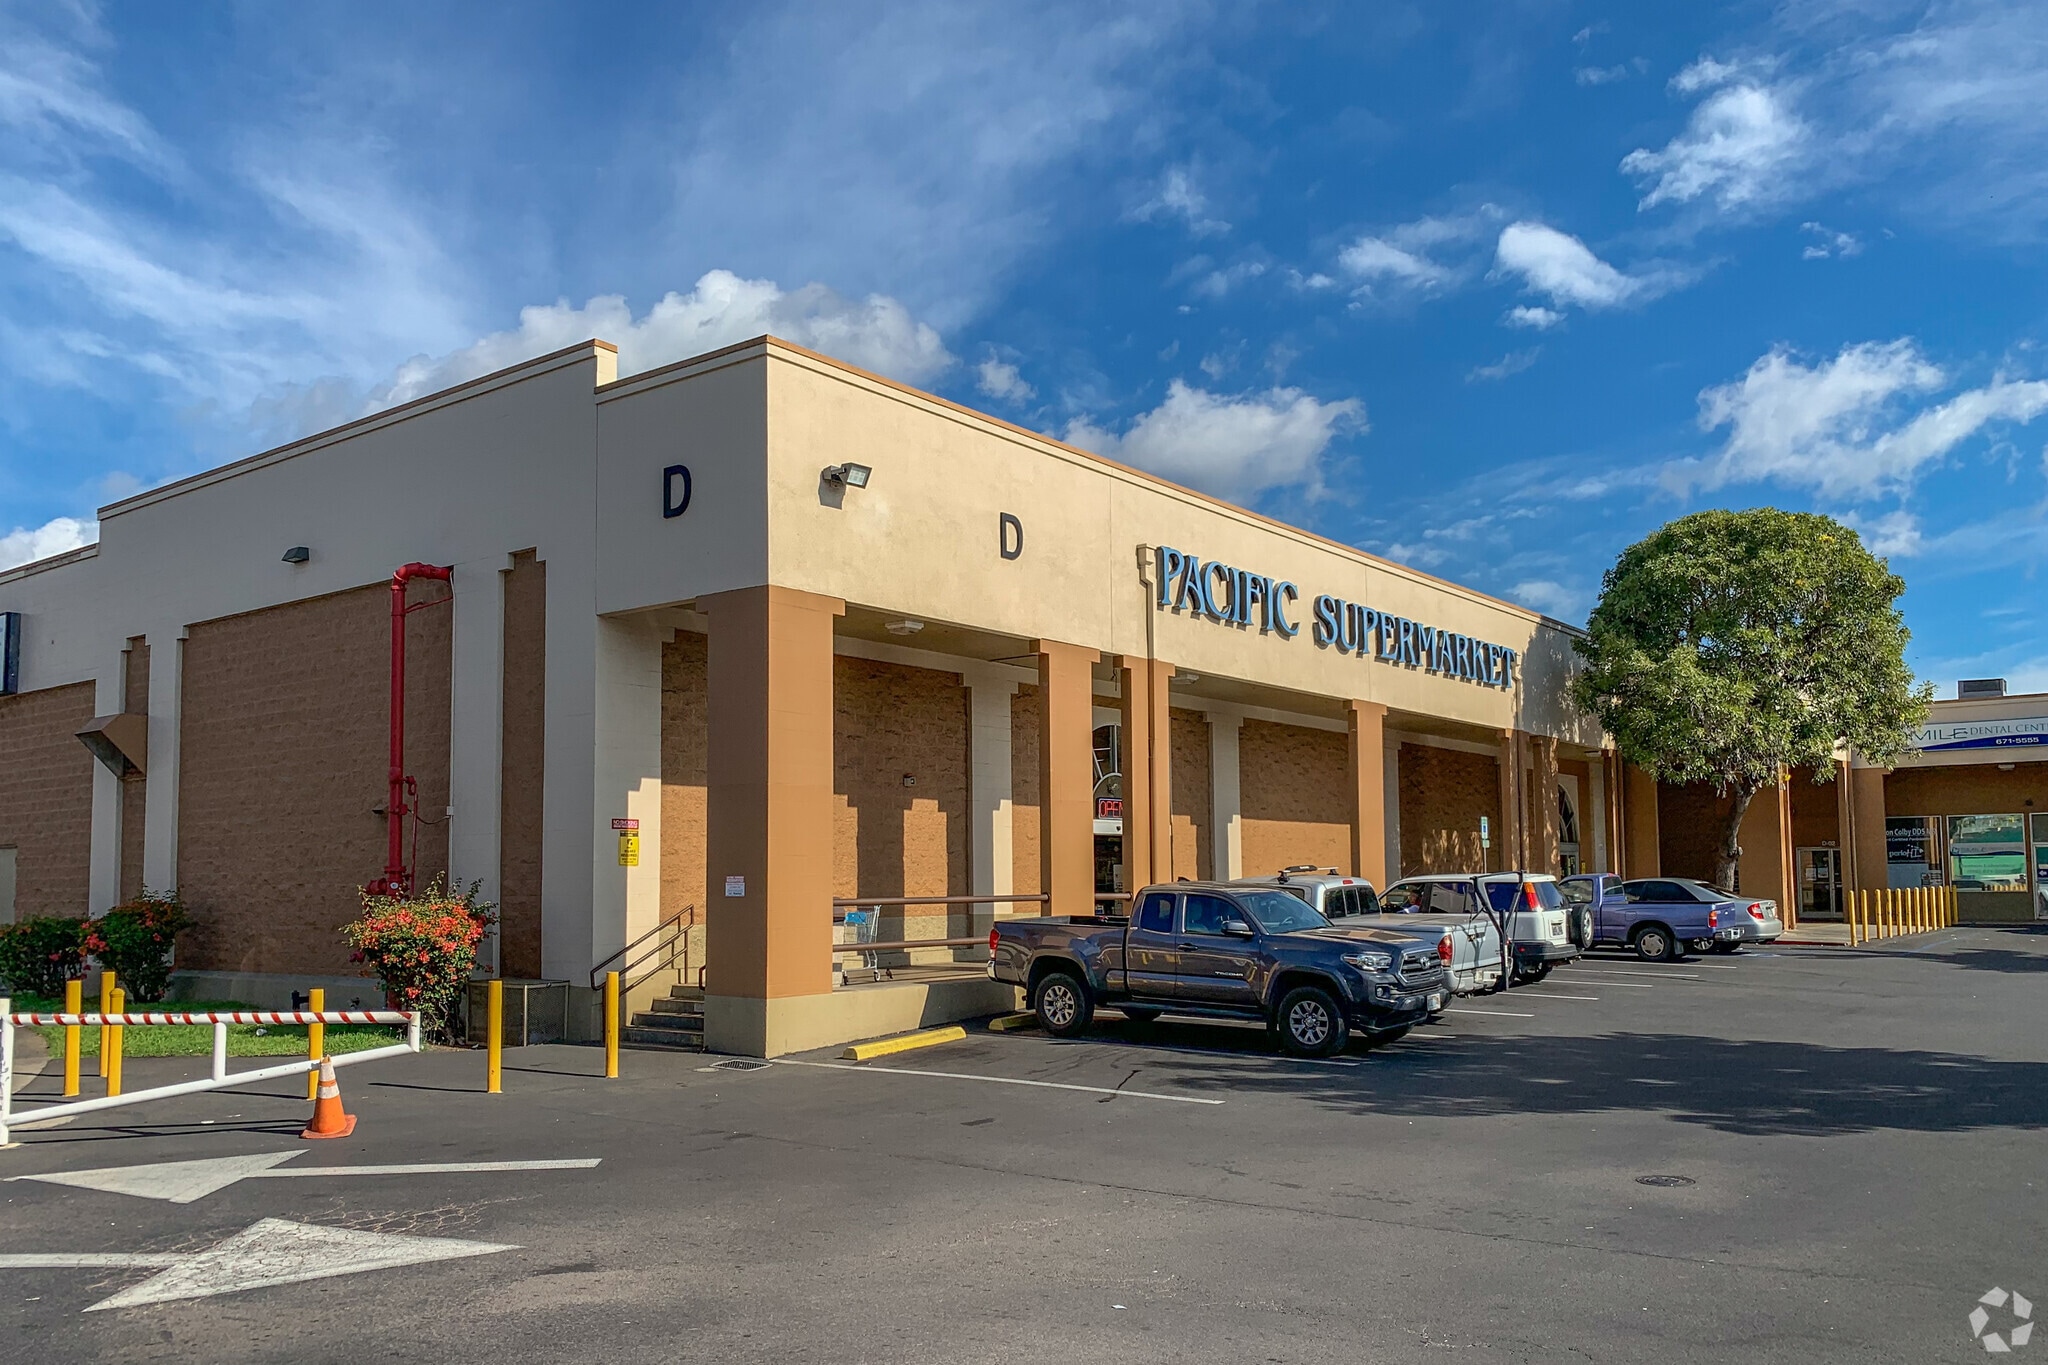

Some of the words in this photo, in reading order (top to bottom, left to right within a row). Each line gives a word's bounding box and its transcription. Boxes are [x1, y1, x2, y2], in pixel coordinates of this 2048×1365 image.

[663, 464, 692, 519] D
[1000, 511, 1024, 561] D
[1157, 545, 1300, 637] PACIFIC
[1313, 594, 1516, 690] SUPERMARKET
[1910, 727, 1968, 741] MILE
[1970, 725, 2011, 735] DENTAL
[2015, 722, 2048, 733] CENT
[1995, 736, 2040, 745] 671-5555
[1894, 828, 1911, 838] Colby
